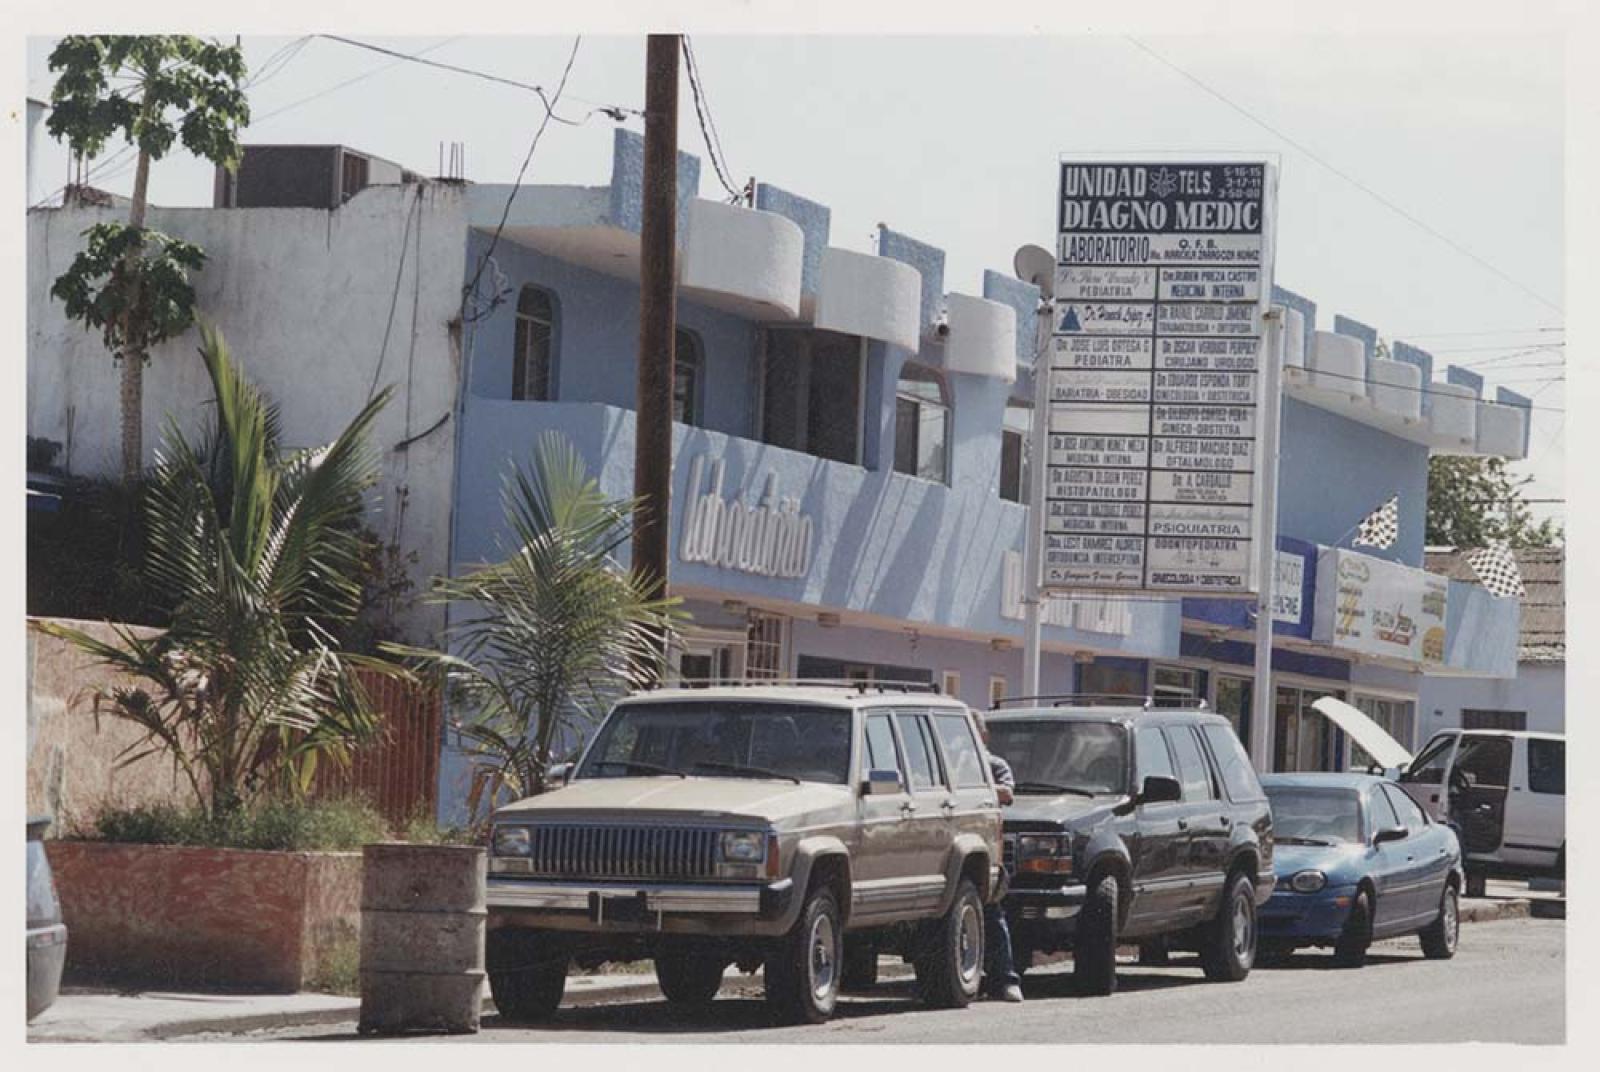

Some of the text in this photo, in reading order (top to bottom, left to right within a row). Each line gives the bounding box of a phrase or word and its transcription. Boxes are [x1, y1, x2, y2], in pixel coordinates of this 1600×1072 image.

[1064, 166, 1147, 197] UNIDAD
[1062, 200, 1260, 230] DIAGNO MEDIC
[1062, 235, 1151, 262] LABORATORIO
[1227, 271, 1257, 283] CASTRO
[1079, 285, 1134, 297] PEDIATRIA
[1171, 284, 1244, 298] MEDICINA INTERNA
[1070, 338, 1090, 352] JOSE
[1092, 339, 1110, 353] LUIS
[1111, 339, 1141, 353] ORTEGA
[1174, 340, 1196, 354] OSCAR
[1074, 353, 1132, 366] PEDIATRA
[1164, 356, 1255, 369] CIRUJANO UROLOGO
[1055, 387, 1148, 400] BARIATRIA OBESIDAD
[1155, 389, 1199, 400] GINECOLOGIA
[1207, 390, 1250, 401] OBSTETRICIA
[1166, 440, 1198, 454] ALFREDO
[1066, 453, 1132, 464] MEDICINA INTERNA
[1166, 456, 1234, 468] OFTALMOLOGO
[1121, 471, 1145, 485] PEREZ
[1056, 486, 1137, 498] HISTOPATOLOGO
[1063, 518, 1128, 531] MEDICINA INTERNA
[1153, 522, 1240, 535] PSIQUIATRIA
[1154, 537, 1238, 551] ODONTOPEDIATRA
[1151, 572, 1195, 584] GINECOLOGIA
[1200, 574, 1242, 586] OBSTETRICIA
